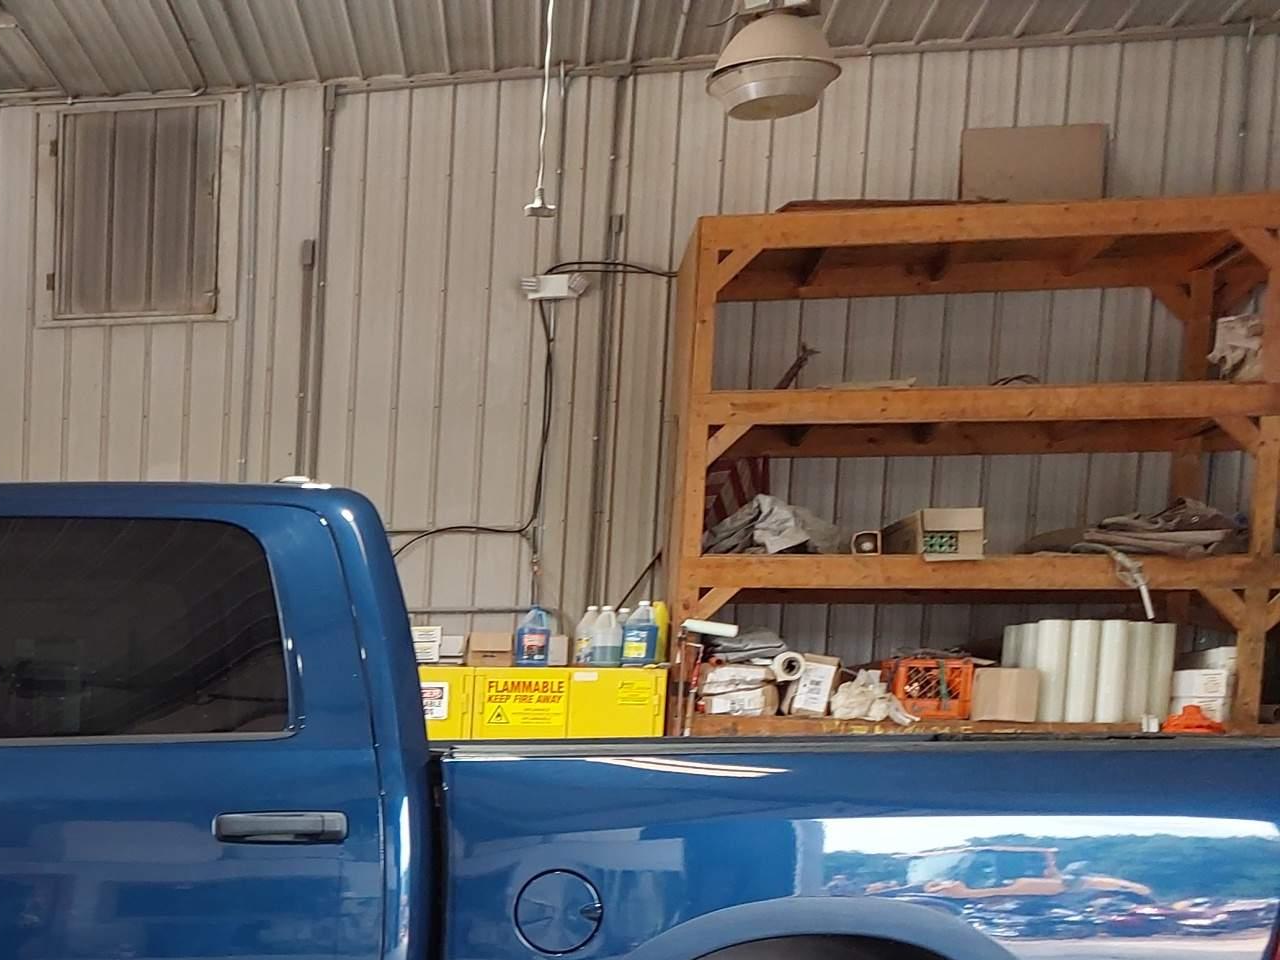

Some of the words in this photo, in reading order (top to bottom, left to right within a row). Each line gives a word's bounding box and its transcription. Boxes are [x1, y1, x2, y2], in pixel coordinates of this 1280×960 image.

[487, 680, 565, 693] FLAMMABLE
[486, 694, 511, 704] KEEP
[513, 694, 534, 704] FIRE
[535, 694, 563, 704] AWAY
